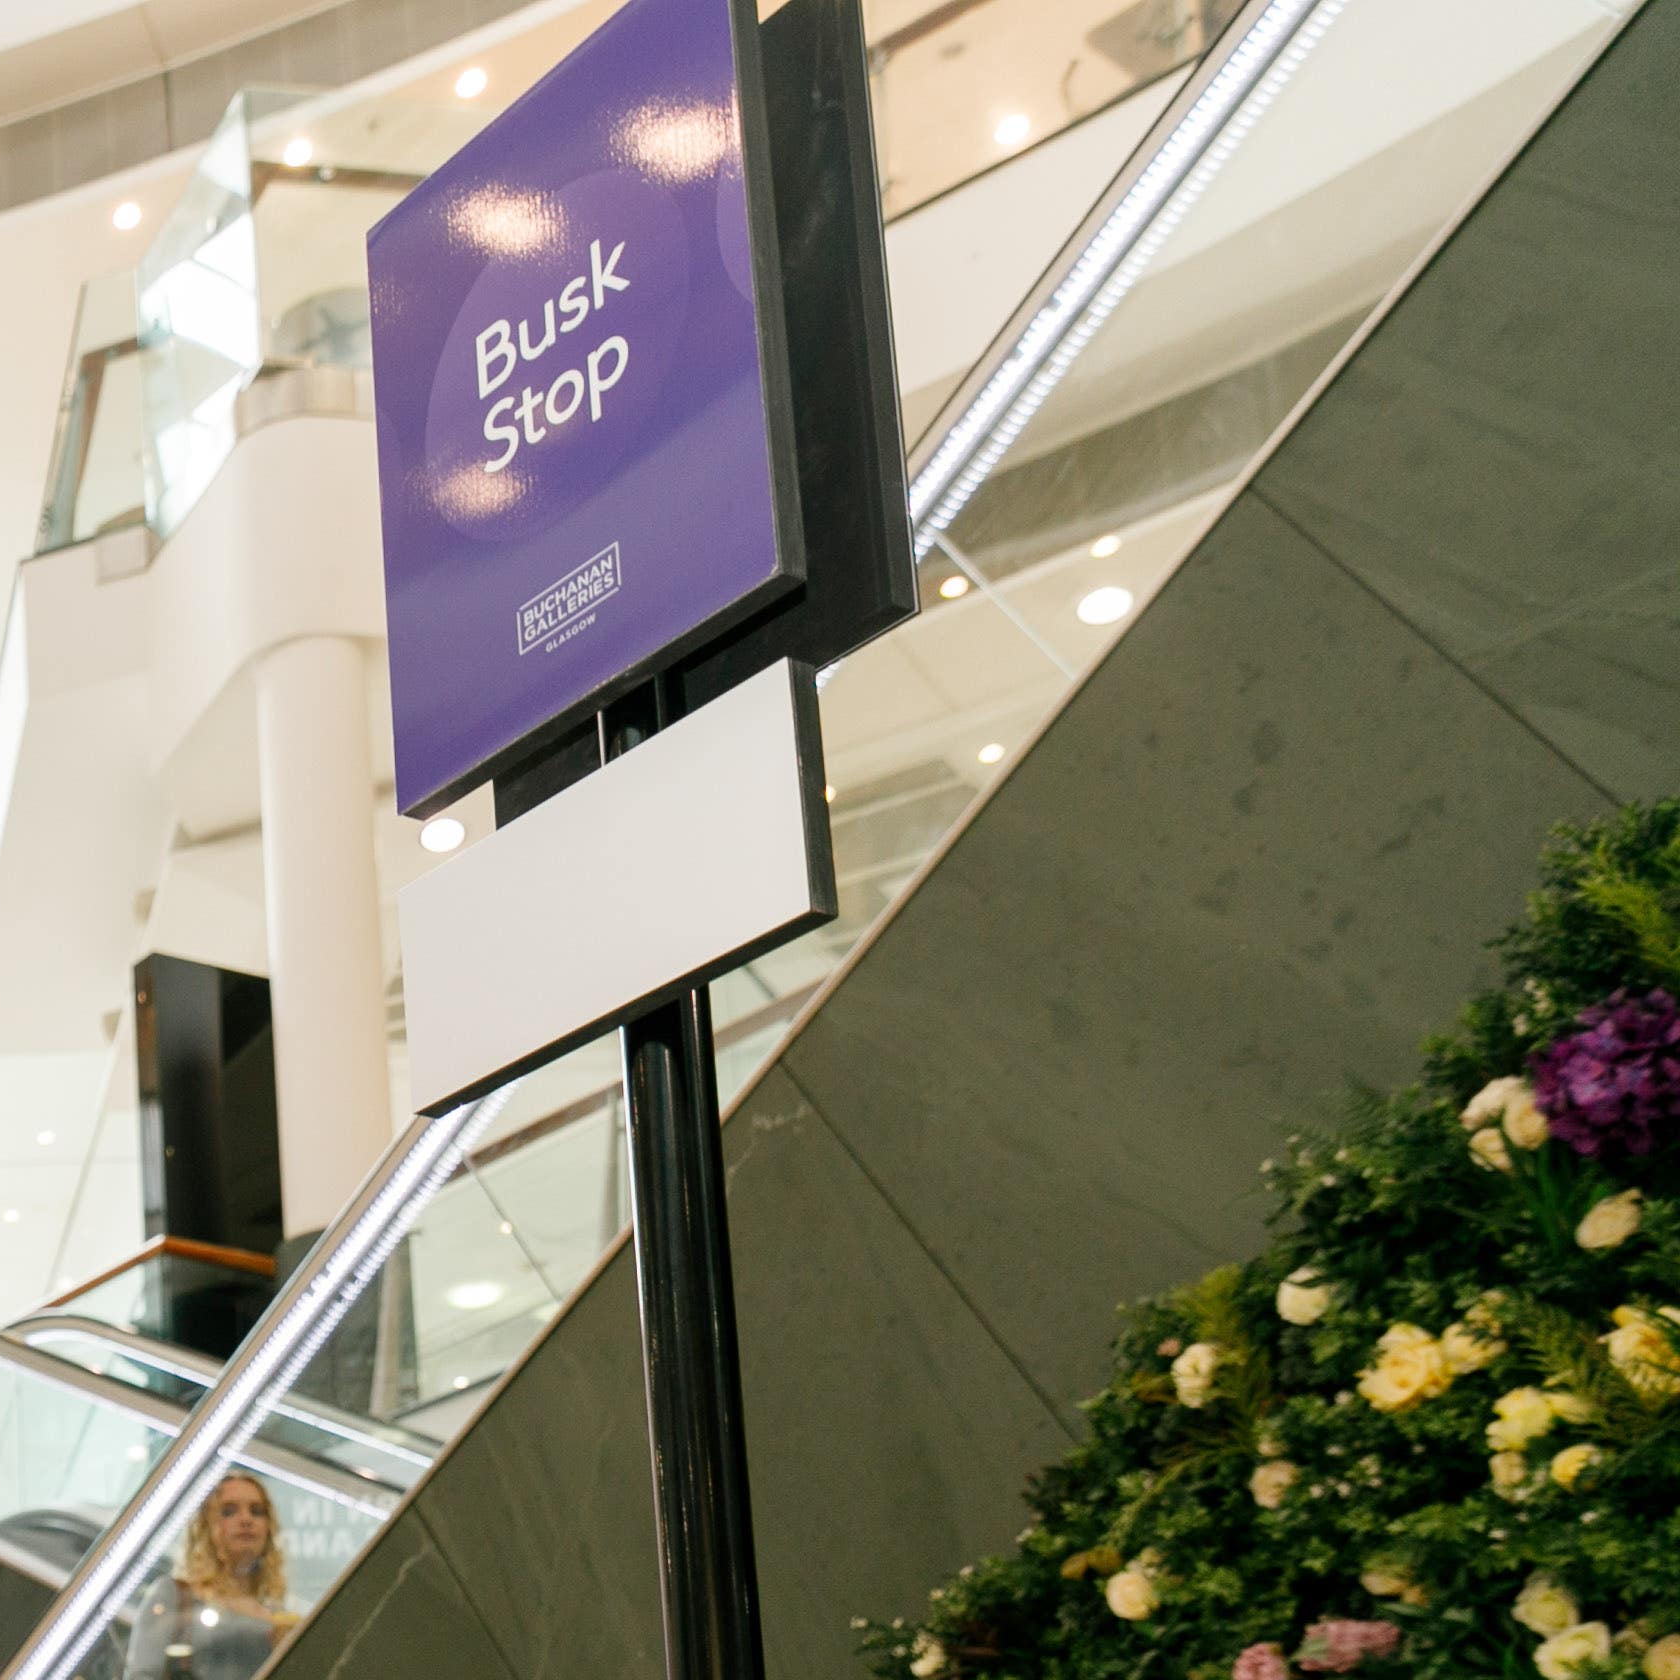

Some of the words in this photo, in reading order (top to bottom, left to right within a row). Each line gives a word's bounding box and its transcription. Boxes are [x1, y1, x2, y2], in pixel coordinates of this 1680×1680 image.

[476, 239, 630, 400] Busk
[484, 335, 629, 473] Stop
[523, 554, 613, 627] BUCHANAN
[524, 571, 615, 641] GALLERIES
[545, 612, 596, 653] GLASGOW
